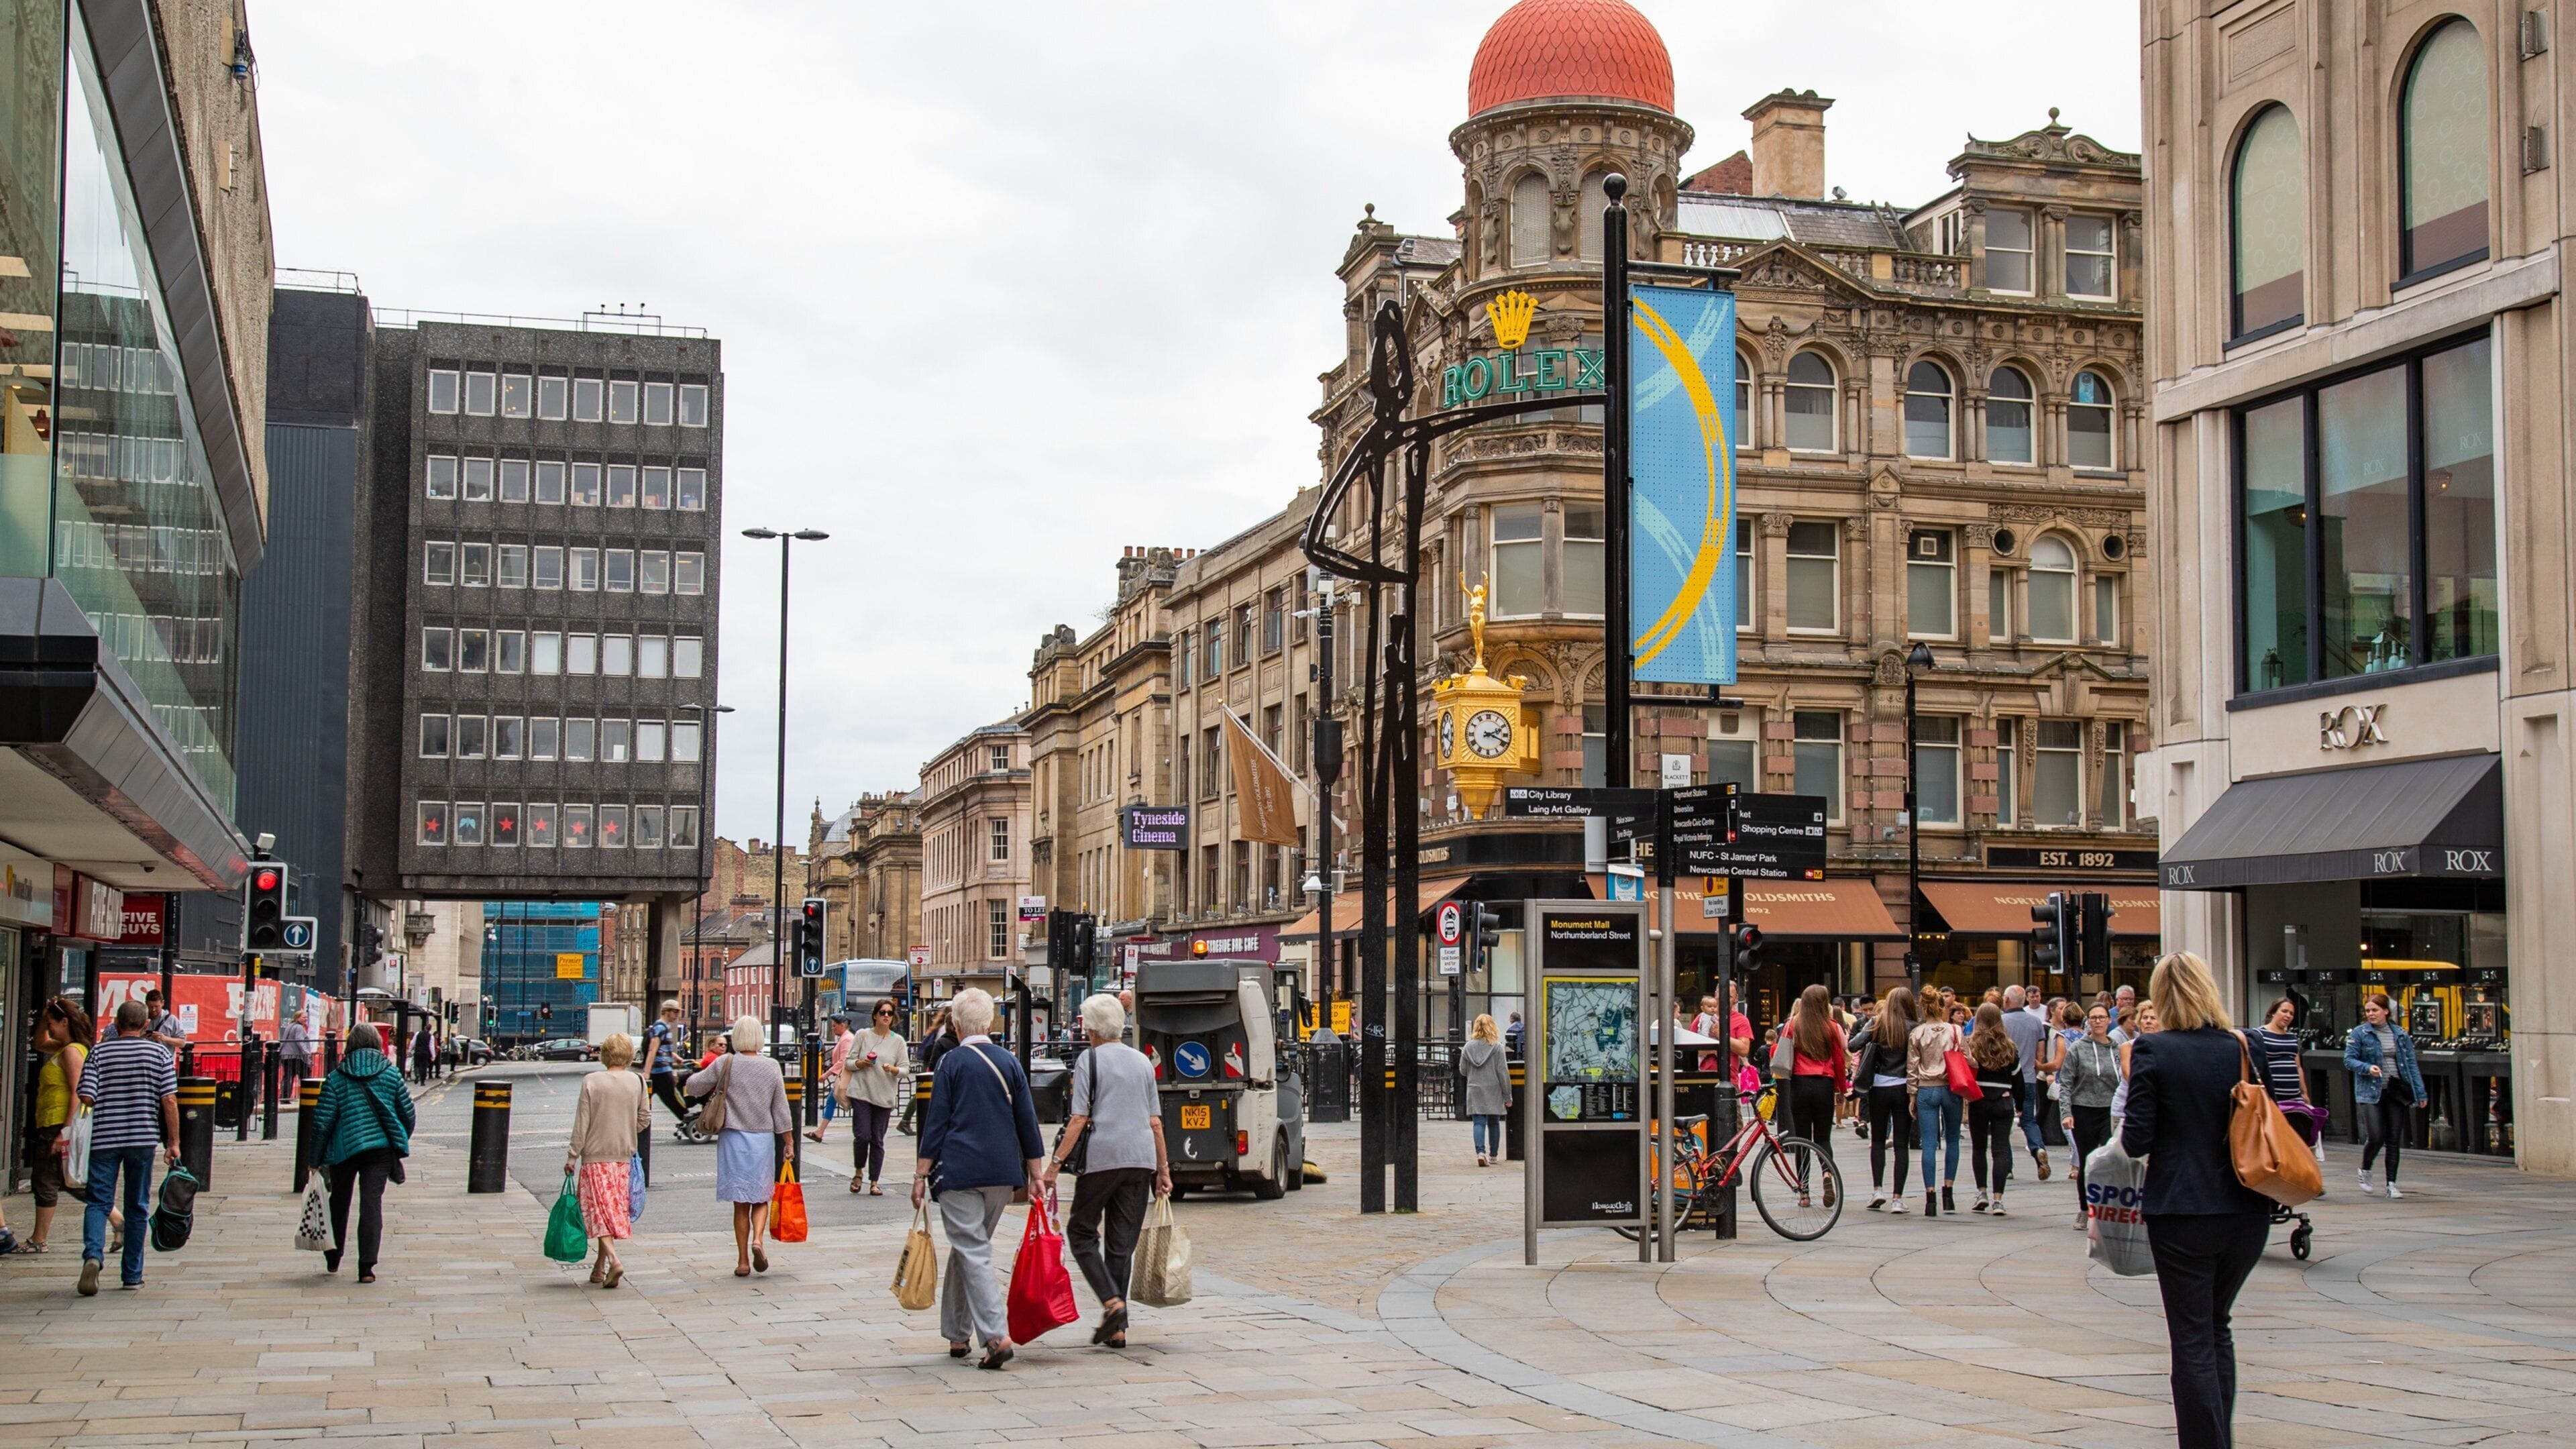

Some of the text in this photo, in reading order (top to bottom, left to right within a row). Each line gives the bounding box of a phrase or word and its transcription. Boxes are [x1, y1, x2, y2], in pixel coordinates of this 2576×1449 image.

[1444, 347, 1605, 409] ROLEX
[2318, 704, 2389, 750] ROX
[1528, 790, 1572, 801] City Library
[1674, 791, 1692, 800] Haymarket
[1528, 805, 1550, 815] Laing
[1564, 806, 1592, 815] Gallery
[1674, 806, 1695, 814] Universities
[1739, 810, 1751, 819] ket
[1132, 811, 1185, 828] Tyneside
[1674, 820, 1692, 828] Newcastle
[1132, 828, 1176, 843] Cinema
[1623, 829, 1633, 837] Bridge
[1741, 824, 1804, 836] Shopping Centre
[1673, 833, 1713, 844] Royal Victoria Infirmary
[1418, 846, 1450, 864] OLDSMITHS
[1689, 851, 1714, 860] NUFC
[1720, 852, 1729, 861] St
[1730, 853, 1758, 862] James'
[1759, 854, 1777, 863] Park
[2039, 851, 2114, 867] EST. 1892
[2445, 850, 2493, 871] ROX
[2373, 852, 2406, 873] ROX
[1690, 865, 1729, 875] Newcastle
[1731, 867, 1758, 876] Central
[1760, 869, 1787, 877] Station
[2168, 865, 2195, 885] ROX
[1744, 892, 1836, 902] OLDSMITHS
[122, 912, 156, 923] FIVE
[121, 924, 160, 934] GUYS
[1550, 920, 1593, 928] Monument
[1609, 931, 1631, 939] Street
[1185, 1108, 1207, 1117] NK15
[1186, 1118, 1205, 1126] KVZ
[1592, 1201, 1625, 1210] Newcastle
